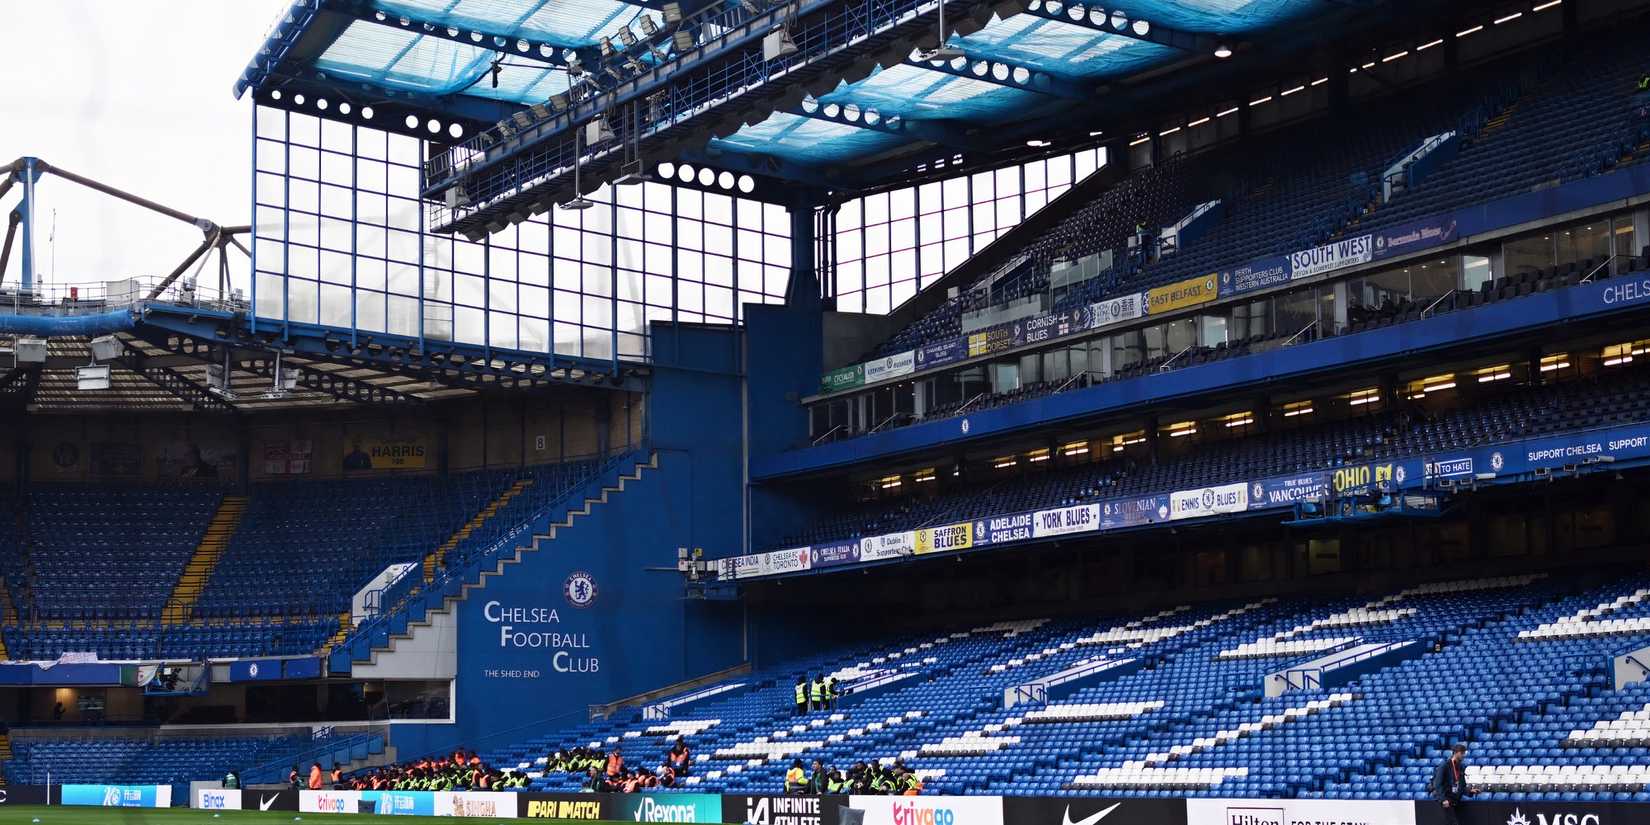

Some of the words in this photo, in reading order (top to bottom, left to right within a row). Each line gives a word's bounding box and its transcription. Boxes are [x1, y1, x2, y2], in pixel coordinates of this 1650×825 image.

[1293, 244, 1334, 270] SOUTH
[1338, 236, 1371, 258] WEST
[1269, 266, 1283, 277] CLUB
[1259, 273, 1288, 287] AUSTRALIA
[1151, 294, 1169, 307] EAST
[1171, 285, 1201, 302] BELFAST
[1026, 313, 1058, 331] CORNISH
[987, 328, 1008, 341] SOUTH
[1026, 329, 1048, 344] BLUES
[371, 445, 425, 457] HARRIS
[1528, 447, 1565, 462] SUPPORT
[1567, 443, 1602, 457] CHELSEA
[1608, 436, 1648, 451] SUPPORT
[1441, 464, 1451, 473] TO
[1452, 461, 1470, 472] HATE
[1284, 479, 1297, 487] TRUE
[1298, 477, 1313, 485] BLUES
[1335, 465, 1370, 492] OHIO
[1216, 492, 1237, 507] BLUES
[990, 514, 1031, 531] ADELAIDE
[1042, 511, 1062, 529] YORK
[1066, 508, 1090, 526] BLUES
[934, 526, 967, 538] SAFFRON
[991, 527, 1031, 543] CHELSEA
[934, 535, 967, 549] BLUES
[773, 558, 799, 570] TORONTO
[569, 572, 592, 582] CHELSEA
[484, 600, 560, 623] CHELSEA
[500, 626, 590, 648] FOOTBALL
[552, 651, 599, 673] CLUB
[484, 670, 499, 678] THE
[501, 670, 521, 678] SHED
[523, 670, 540, 678] END
[317, 794, 345, 811] trivago
[465, 800, 497, 817] SINGHA
[560, 801, 600, 819] MATCH
[644, 797, 696, 823] Rexona
[773, 797, 821, 814] INFINITE
[892, 801, 954, 825] trivago
[1231, 815, 1279, 825] Hilton
[1536, 813, 1600, 825] MSC
